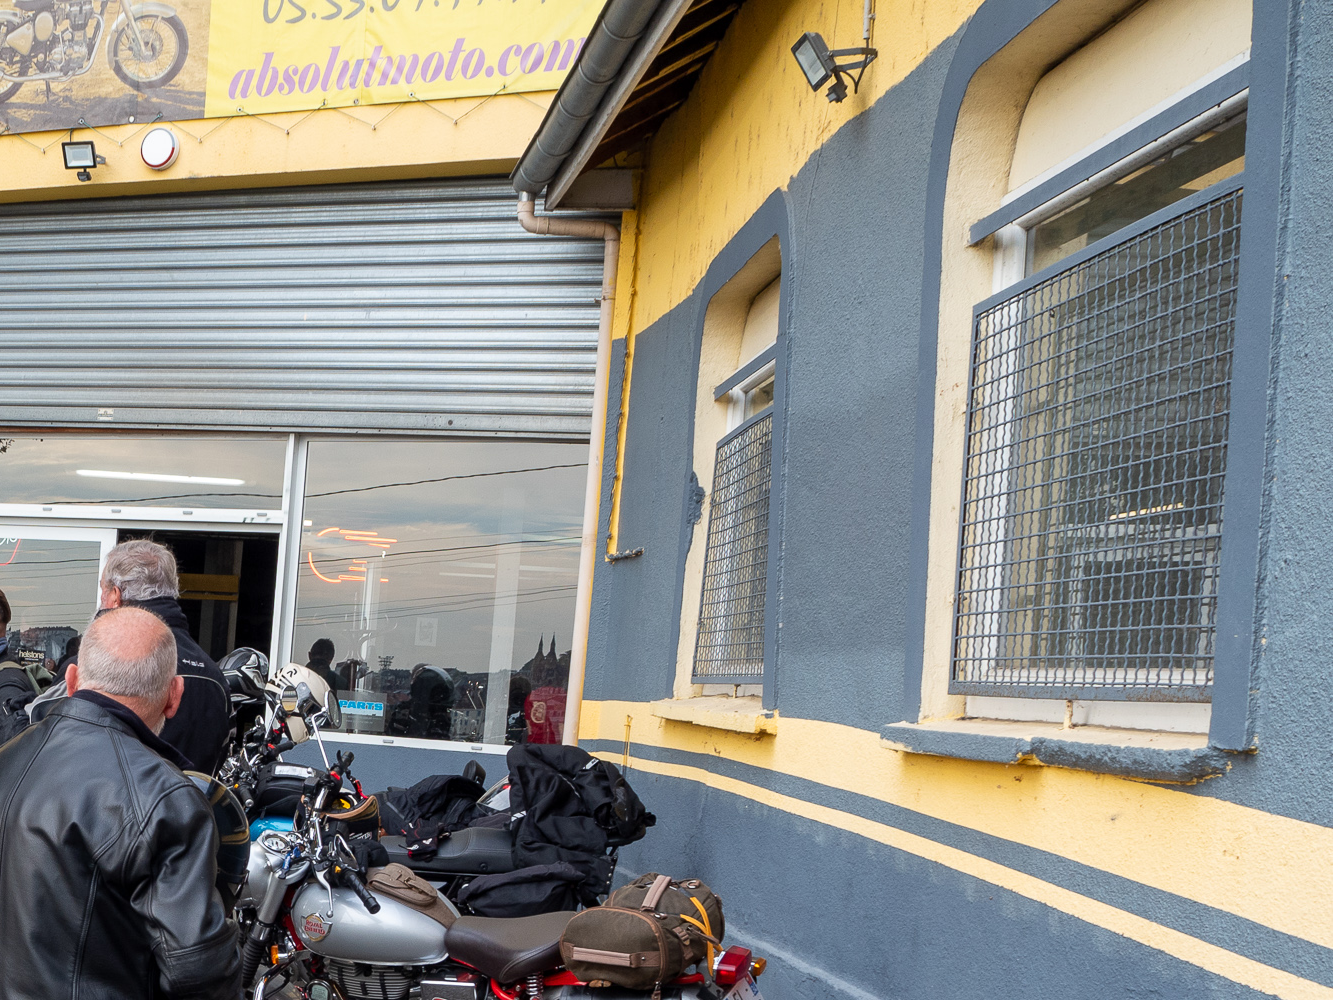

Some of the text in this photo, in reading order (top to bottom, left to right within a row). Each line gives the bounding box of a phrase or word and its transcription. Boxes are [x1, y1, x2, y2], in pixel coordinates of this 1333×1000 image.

[228, 37, 587, 100] absolutmoto.com
[18, 649, 45, 660] helstons
[338, 699, 384, 711] PARTS
